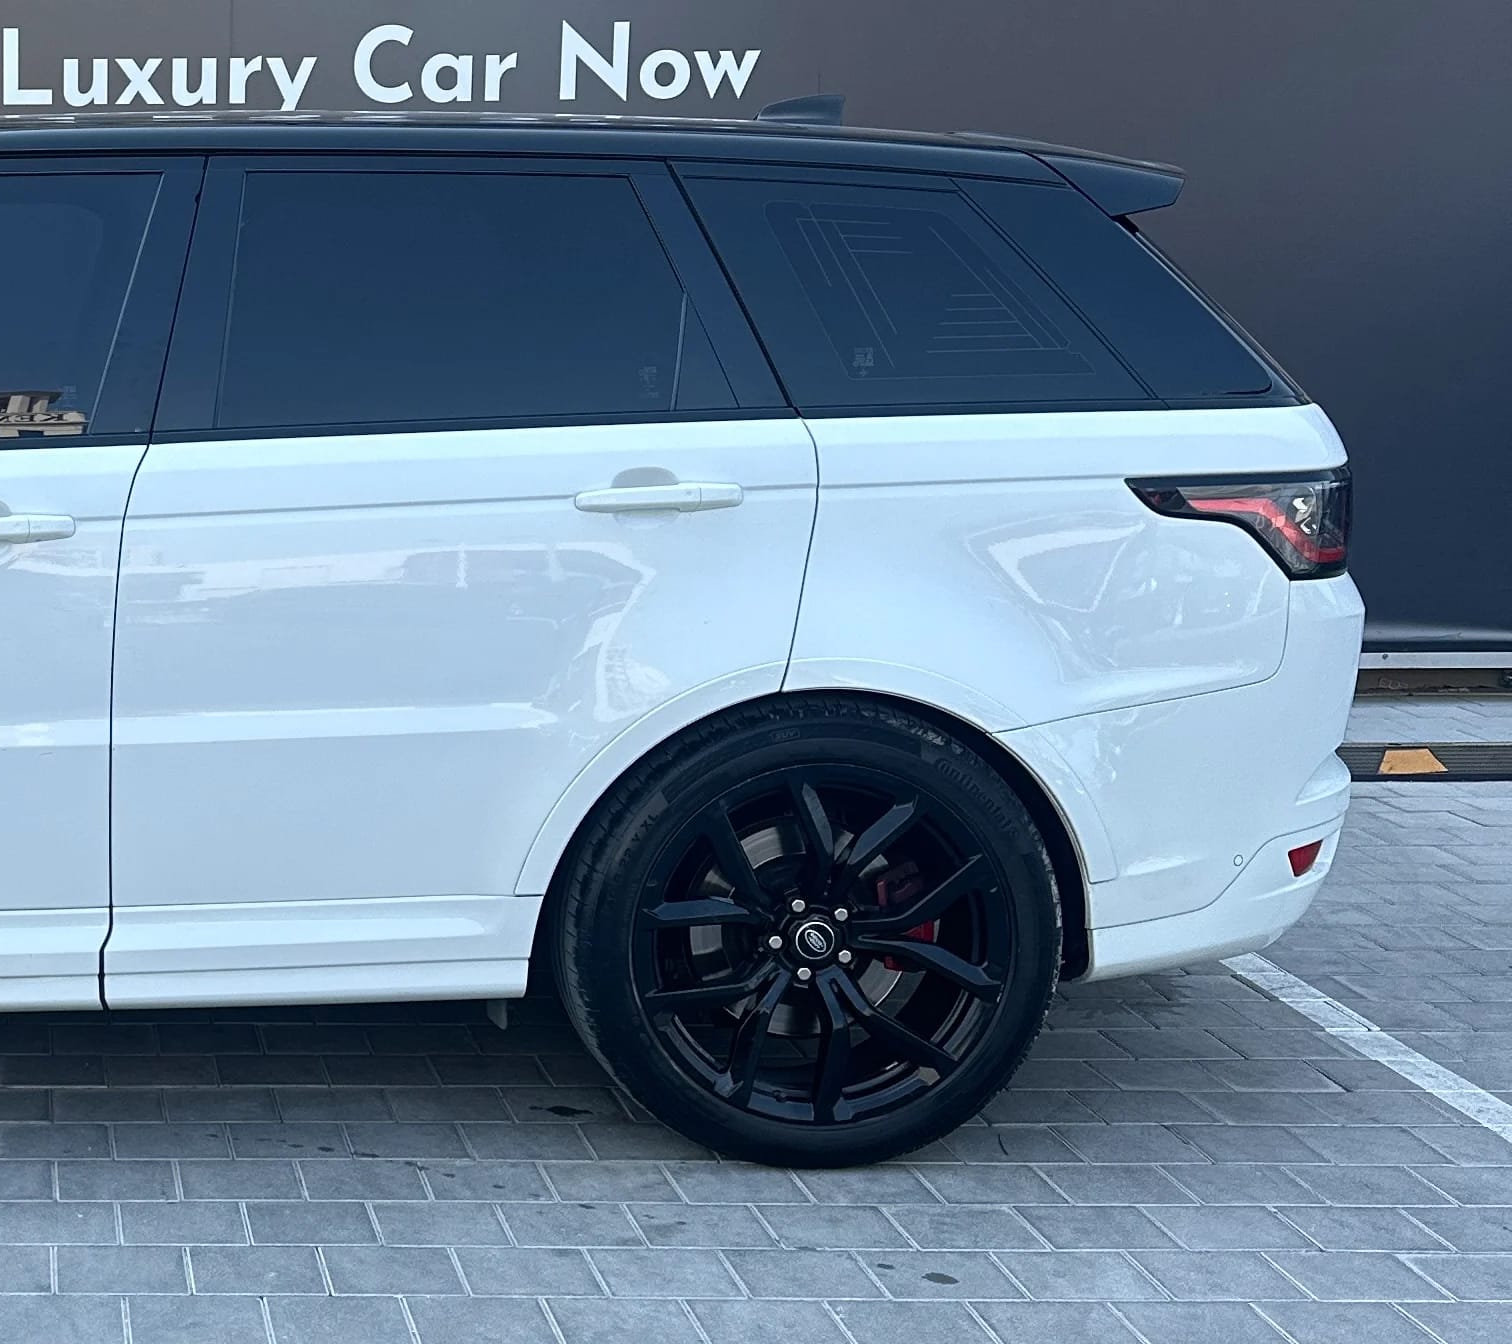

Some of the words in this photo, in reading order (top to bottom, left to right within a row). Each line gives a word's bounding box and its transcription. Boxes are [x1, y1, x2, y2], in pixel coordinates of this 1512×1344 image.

[3, 27, 318, 112] Luxury
[353, 24, 518, 104] Car
[559, 19, 761, 102] Now
